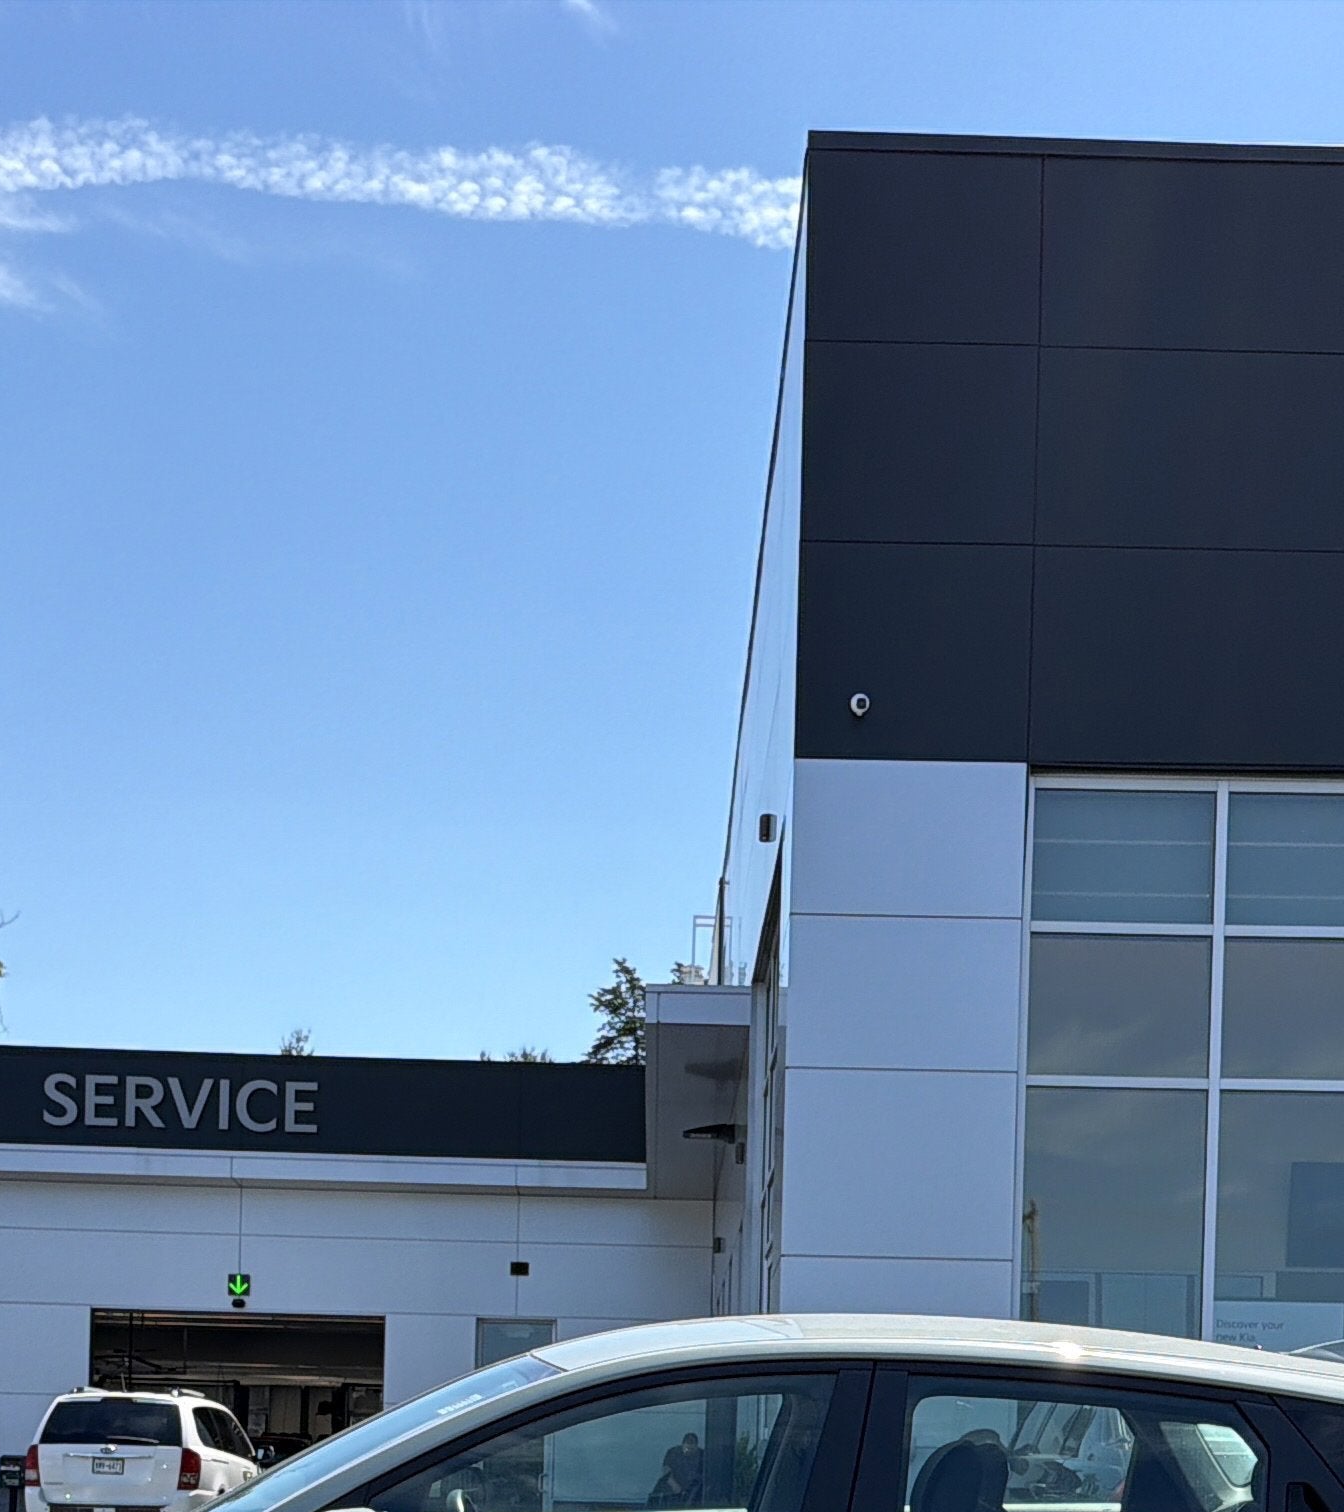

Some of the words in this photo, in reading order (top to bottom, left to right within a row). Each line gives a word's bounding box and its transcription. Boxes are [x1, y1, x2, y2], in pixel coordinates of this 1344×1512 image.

[42, 1072, 319, 1133] SERVICE
[1216, 1319, 1258, 1329] Discover
[1261, 1321, 1284, 1331] your
